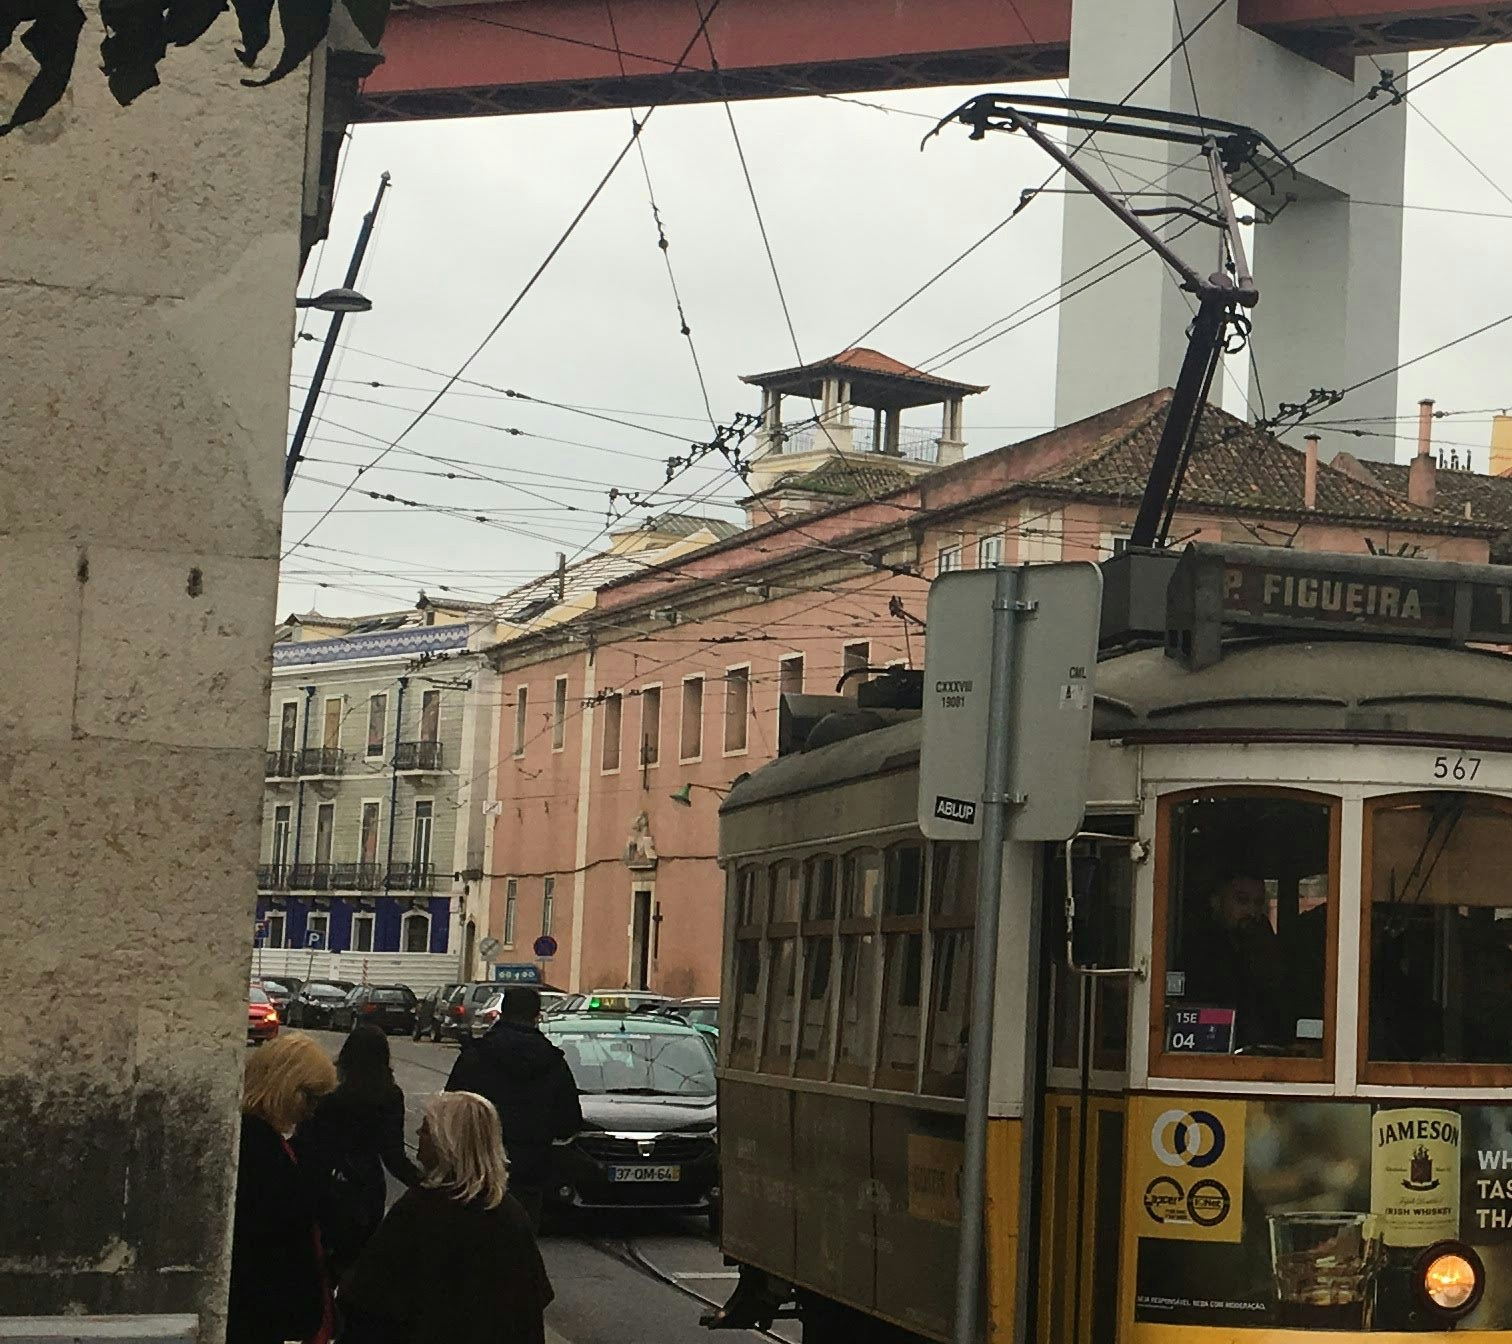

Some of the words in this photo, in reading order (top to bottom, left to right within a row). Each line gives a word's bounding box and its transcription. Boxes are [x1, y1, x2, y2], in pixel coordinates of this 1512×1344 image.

[1263, 573, 1423, 620] FIGUEIRA
[1434, 756, 1482, 780] 567
[936, 799, 975, 821] ABLUP
[1176, 1012, 1198, 1024] 15E
[1172, 1032, 1196, 1049] 04
[1378, 1119, 1460, 1147] JAMESON
